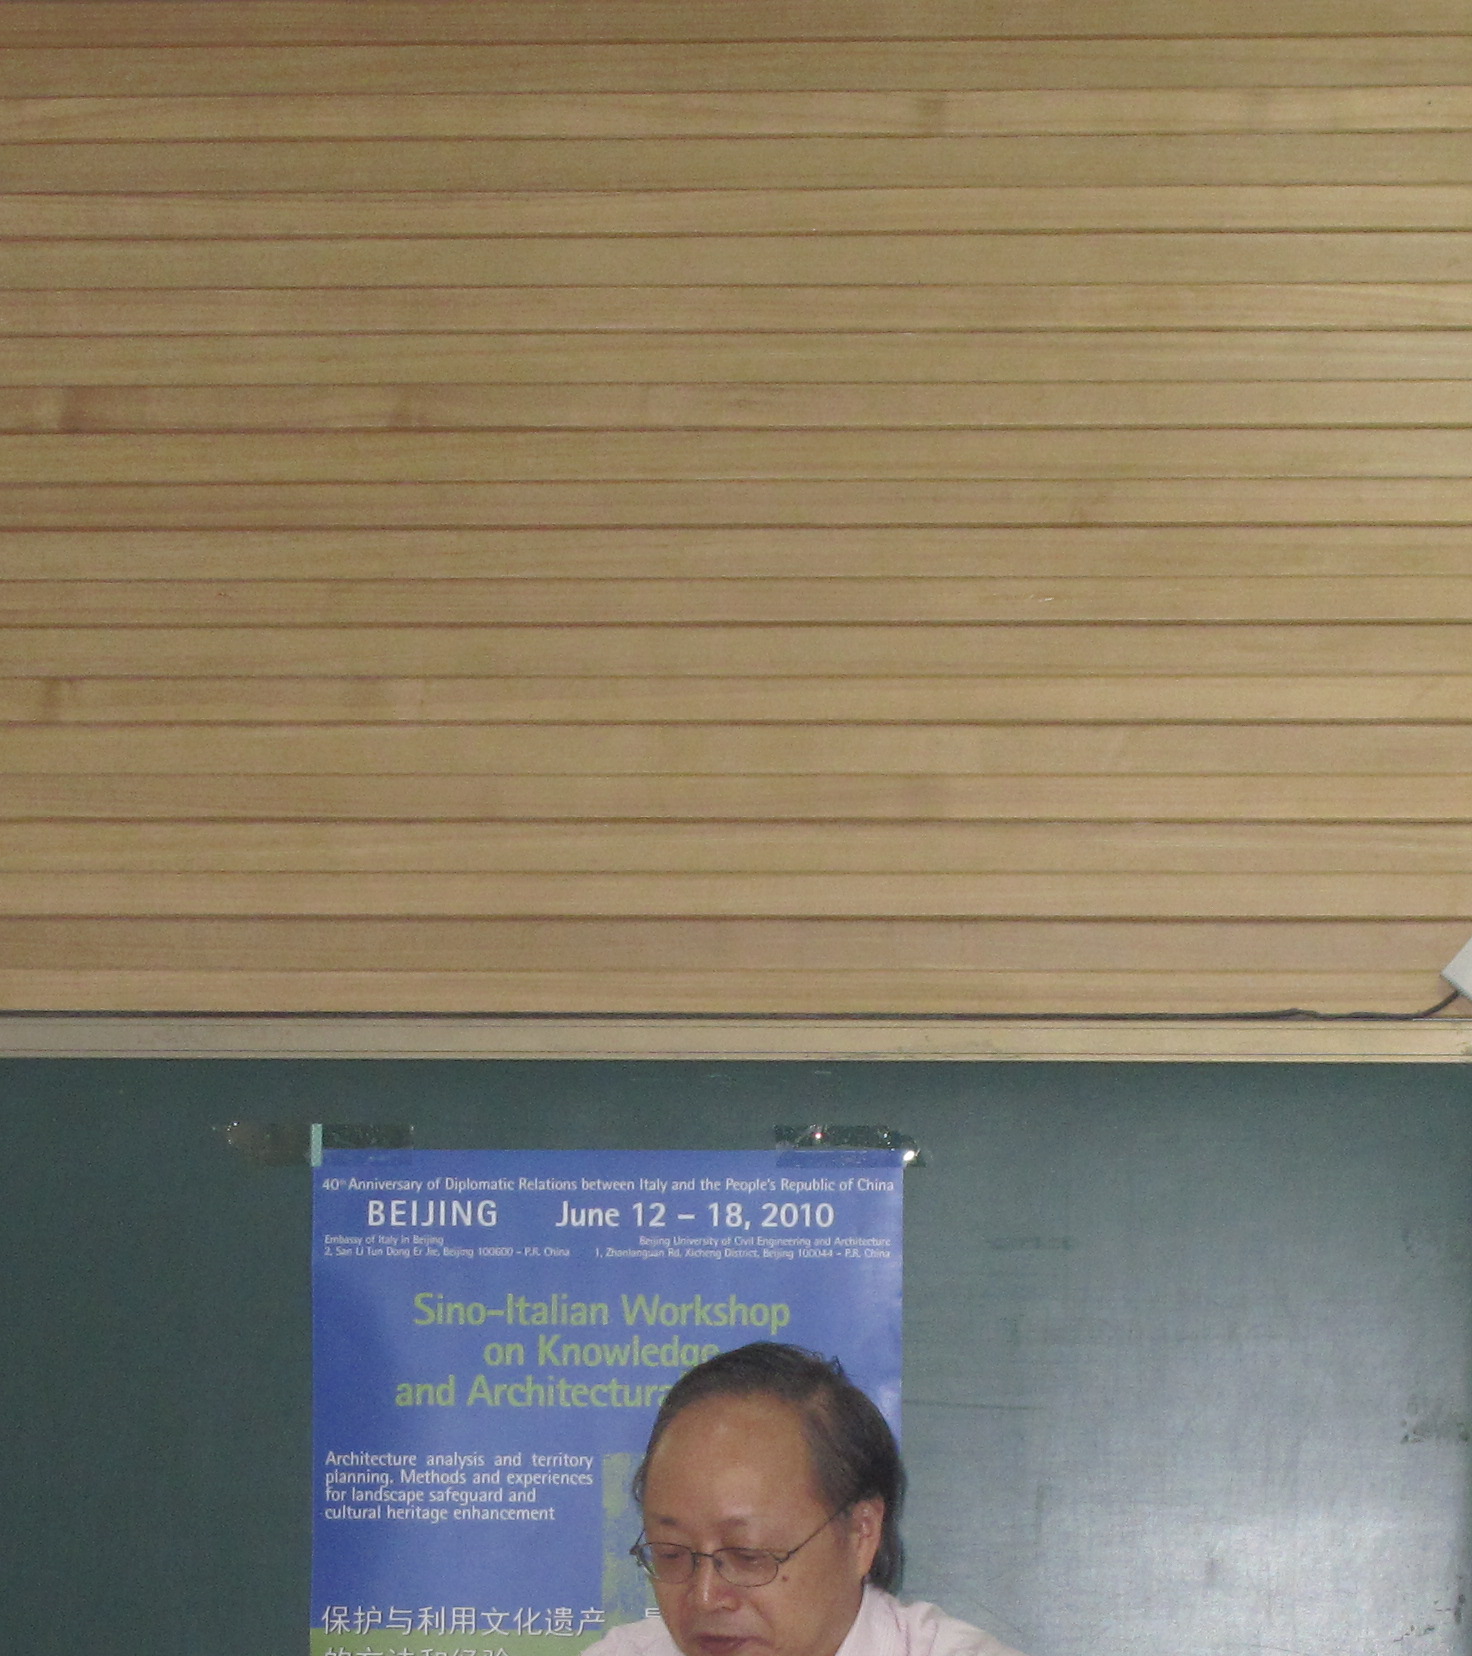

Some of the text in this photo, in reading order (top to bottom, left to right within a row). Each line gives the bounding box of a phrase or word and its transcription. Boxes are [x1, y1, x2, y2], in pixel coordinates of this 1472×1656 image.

[348, 1178, 423, 1192] Anniversary
[428, 1178, 441, 1190] of
[445, 1178, 515, 1192] Diplomatic
[519, 1178, 577, 1191] Relations
[581, 1178, 634, 1191] between
[640, 1178, 667, 1192] Italy
[671, 1178, 695, 1191] and
[700, 1178, 721, 1191] the
[726, 1178, 776, 1193] People's
[780, 1178, 836, 1193] Republic
[839, 1178, 854, 1191] of
[857, 1178, 894, 1191] China
[368, 1200, 498, 1227] BEIJING
[555, 1200, 621, 1227] June
[632, 1202, 666, 1228] 12
[708, 1202, 750, 1230] 18,
[761, 1202, 835, 1228] 2010
[621, 1294, 790, 1334] Workshop
[484, 1342, 524, 1367] on
[396, 1374, 455, 1407] and
[325, 1451, 593, 1469] Architecture analysis and territory
[401, 1470, 466, 1485] Methods
[472, 1470, 499, 1485] and
[507, 1470, 593, 1487] experiences
[325, 1487, 536, 1505] for landscape safeguard and
[325, 1505, 555, 1523] cultural heritage enhancement
[321, 1605, 606, 1637] 保护与利用文化遗产
